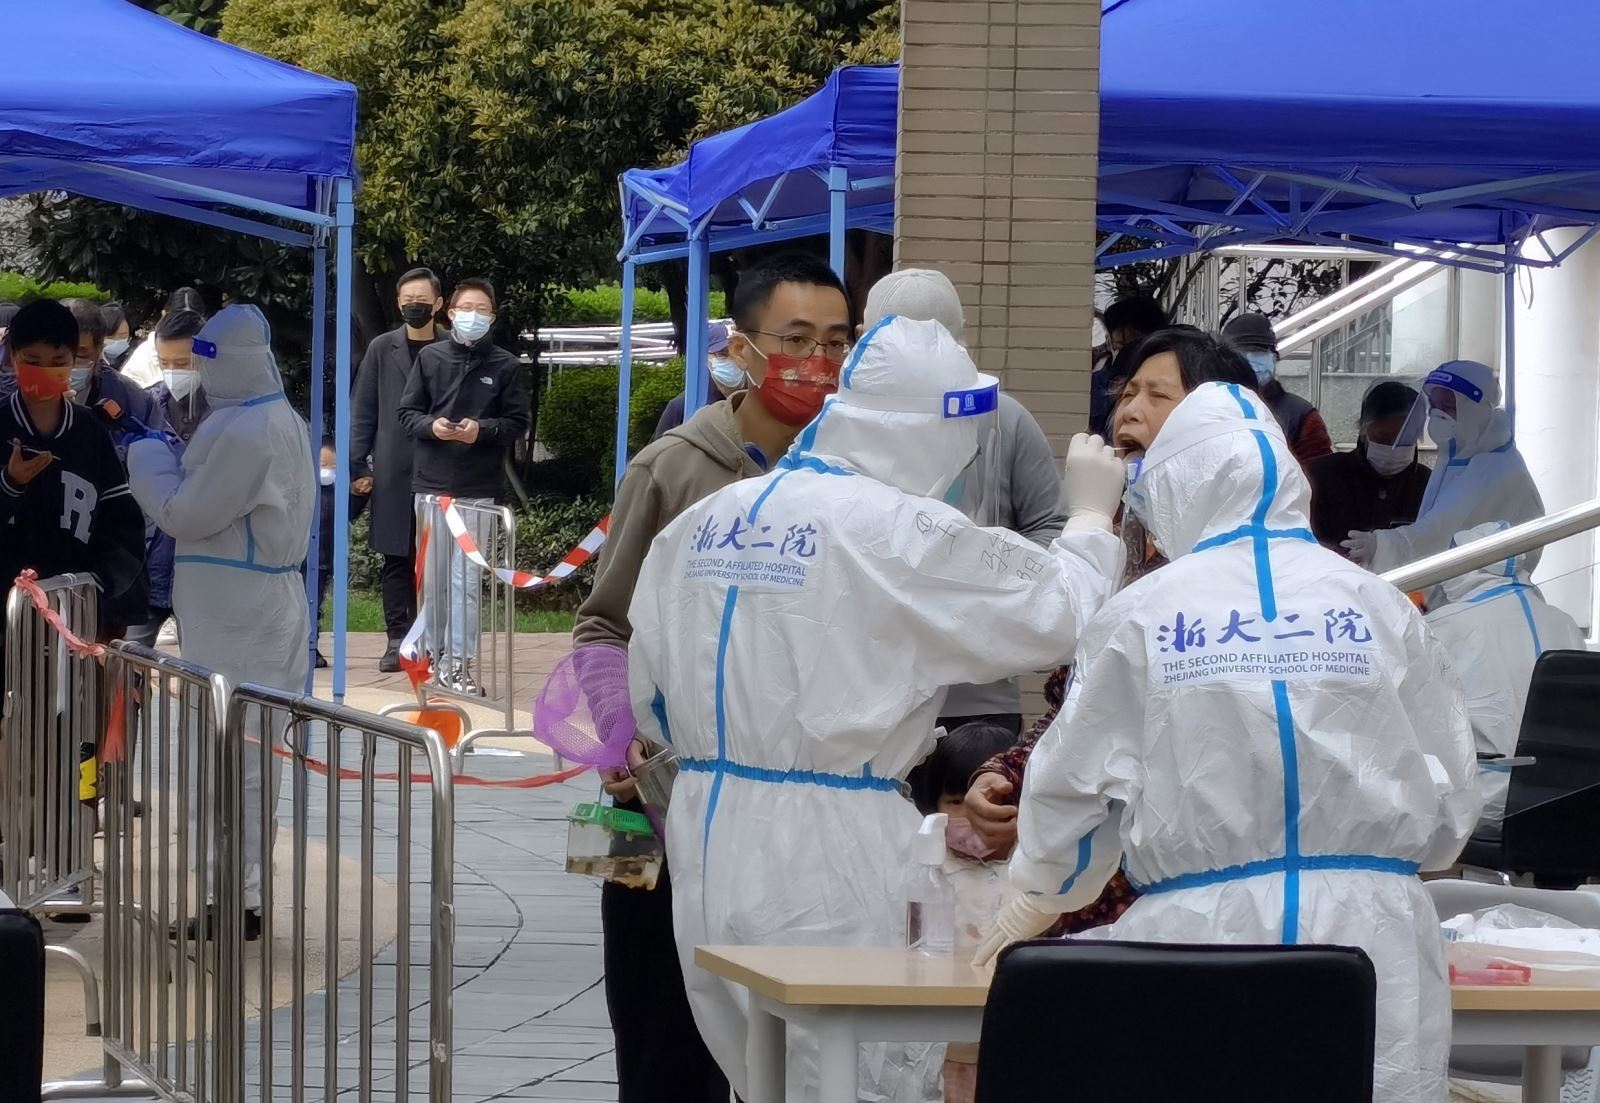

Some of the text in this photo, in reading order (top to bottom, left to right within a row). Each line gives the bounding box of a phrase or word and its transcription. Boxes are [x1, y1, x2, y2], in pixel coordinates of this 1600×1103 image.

[60, 470, 97, 544] R
[690, 514, 817, 557] 浙大二院
[697, 558, 725, 568] SECOND
[725, 560, 764, 571] AFFILIATED
[764, 562, 807, 577] HOSPITAL
[760, 573, 770, 581] OF
[769, 574, 806, 587] MEDICINE
[1156, 607, 1373, 653] 浙大二院
[1162, 651, 1370, 673] THE SECOND AFFILIATED HOSPITAL
[1164, 664, 1370, 684] ZHEJIANG UNIVERSITY SCHOOL OF MEDICINE
